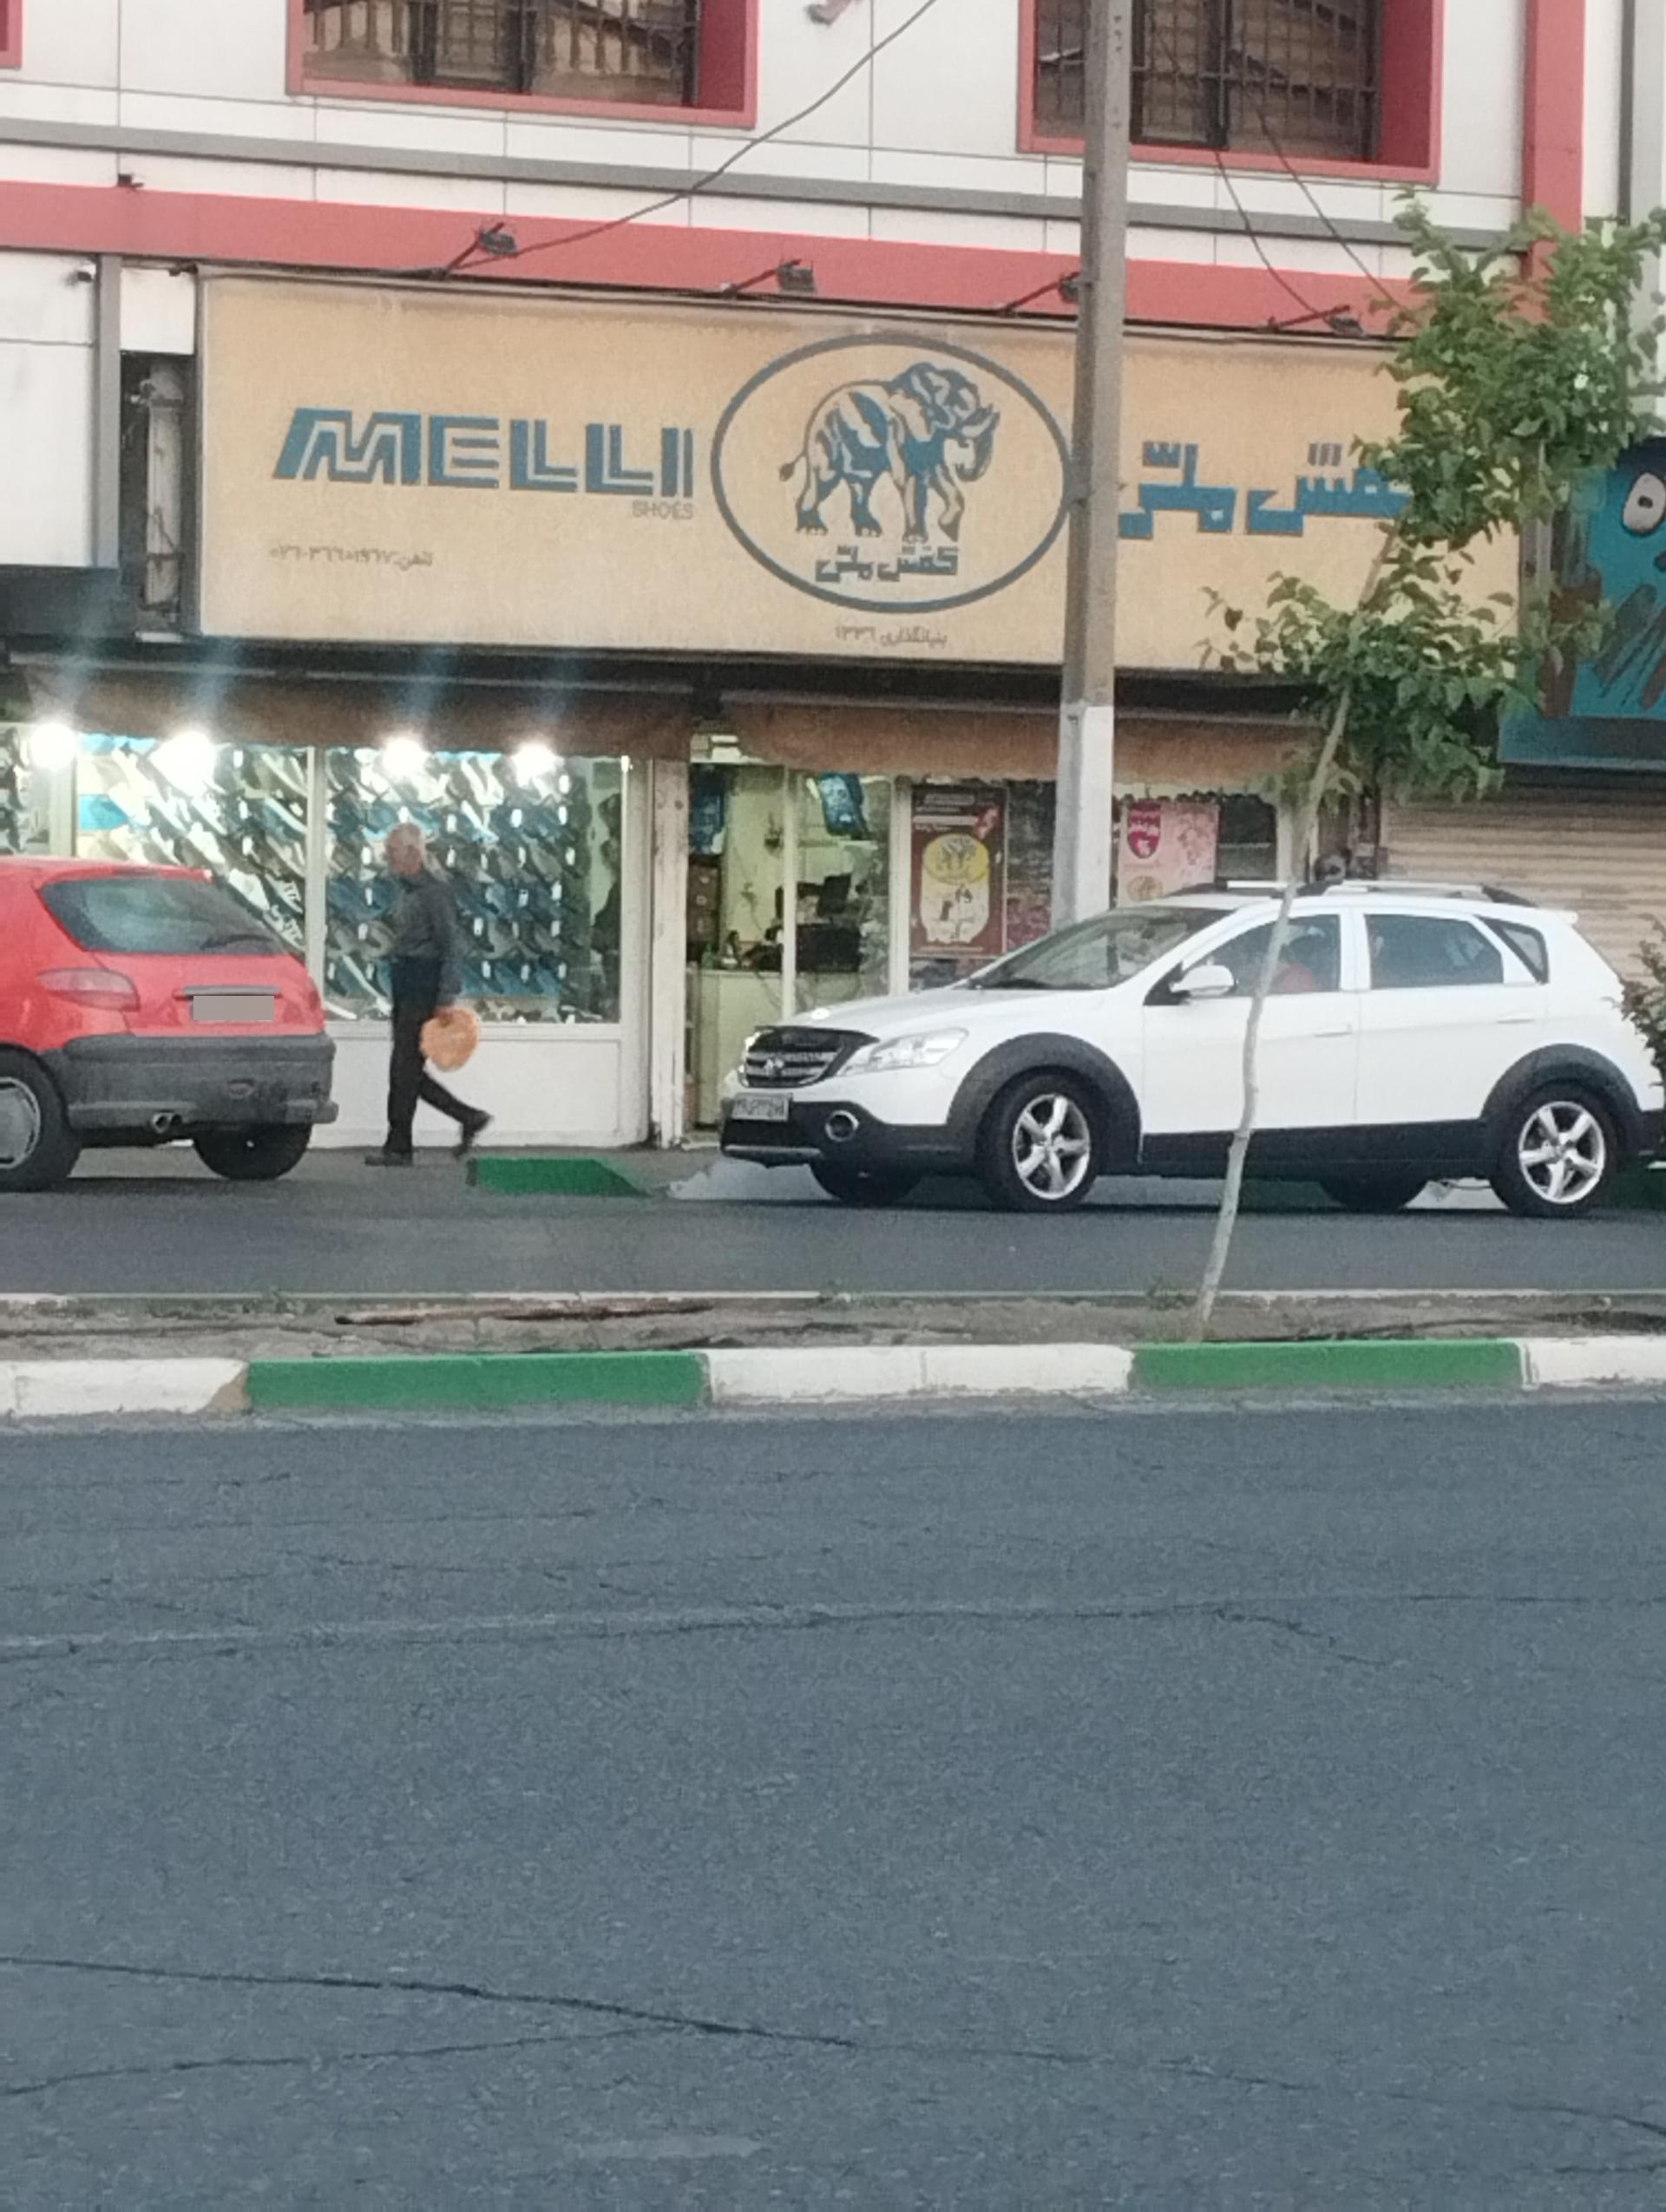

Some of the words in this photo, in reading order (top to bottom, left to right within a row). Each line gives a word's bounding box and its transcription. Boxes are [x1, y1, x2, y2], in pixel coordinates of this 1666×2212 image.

[272, 407, 693, 498] MELLI
[632, 501, 694, 520] SHOES
[1246, 441, 1418, 537] فش
[877, 545, 959, 583] کفش
